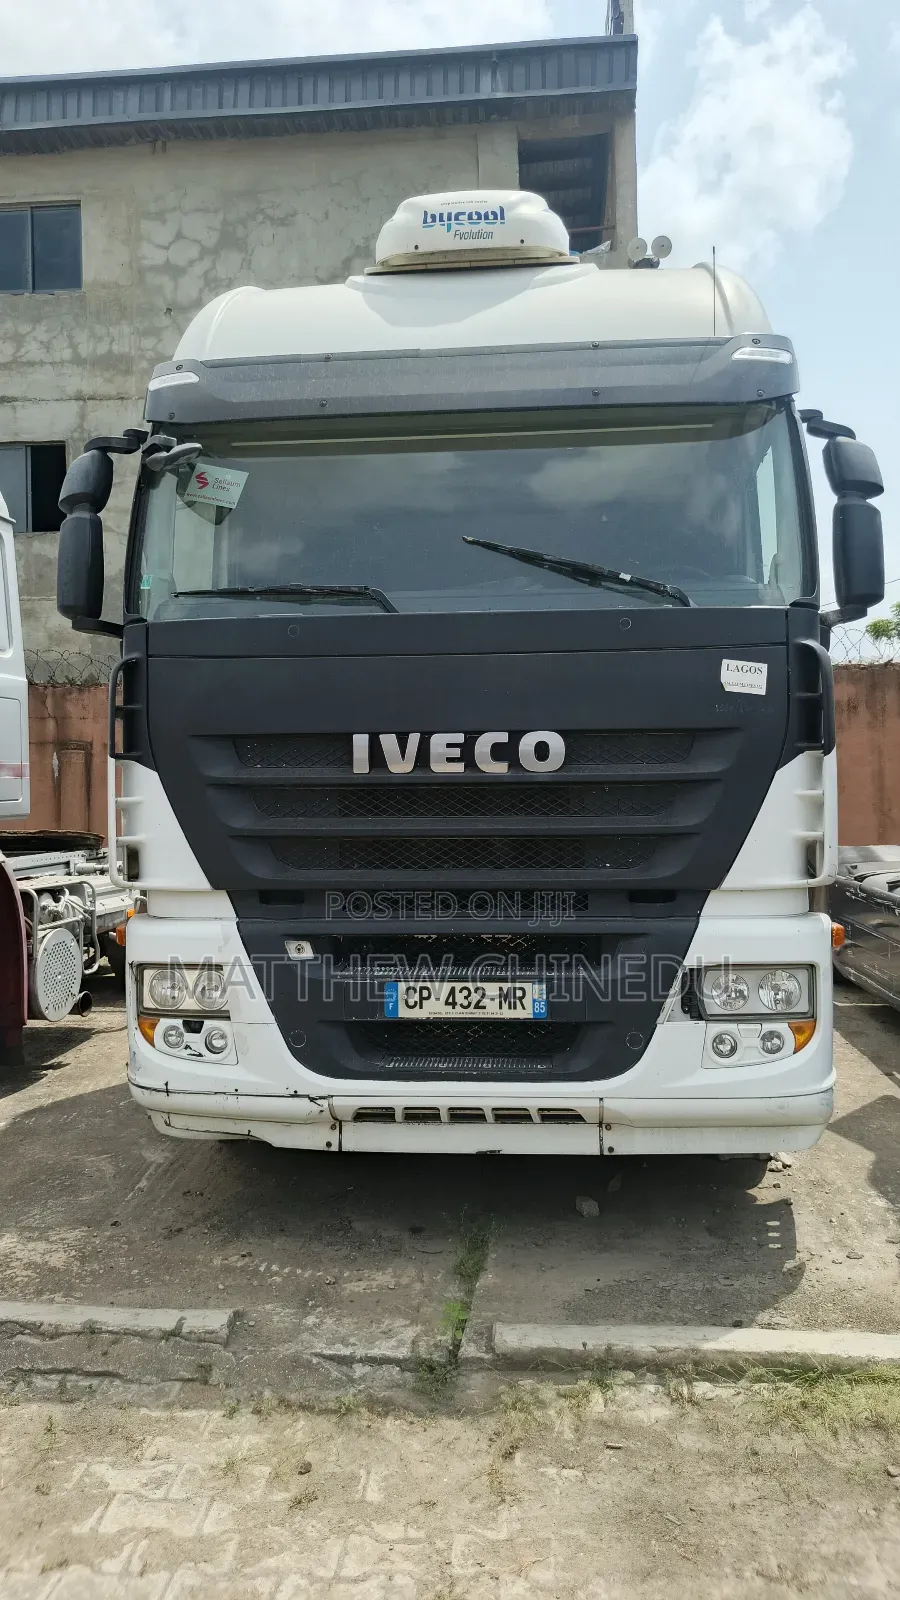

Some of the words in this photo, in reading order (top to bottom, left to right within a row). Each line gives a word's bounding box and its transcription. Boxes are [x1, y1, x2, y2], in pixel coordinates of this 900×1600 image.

[422, 205, 505, 233] bycool
[726, 663, 763, 675] LAGOS
[352, 731, 566, 774] IVECO
[404, 985, 527, 1010] CP-432-MR
[534, 1002, 546, 1013] 85
